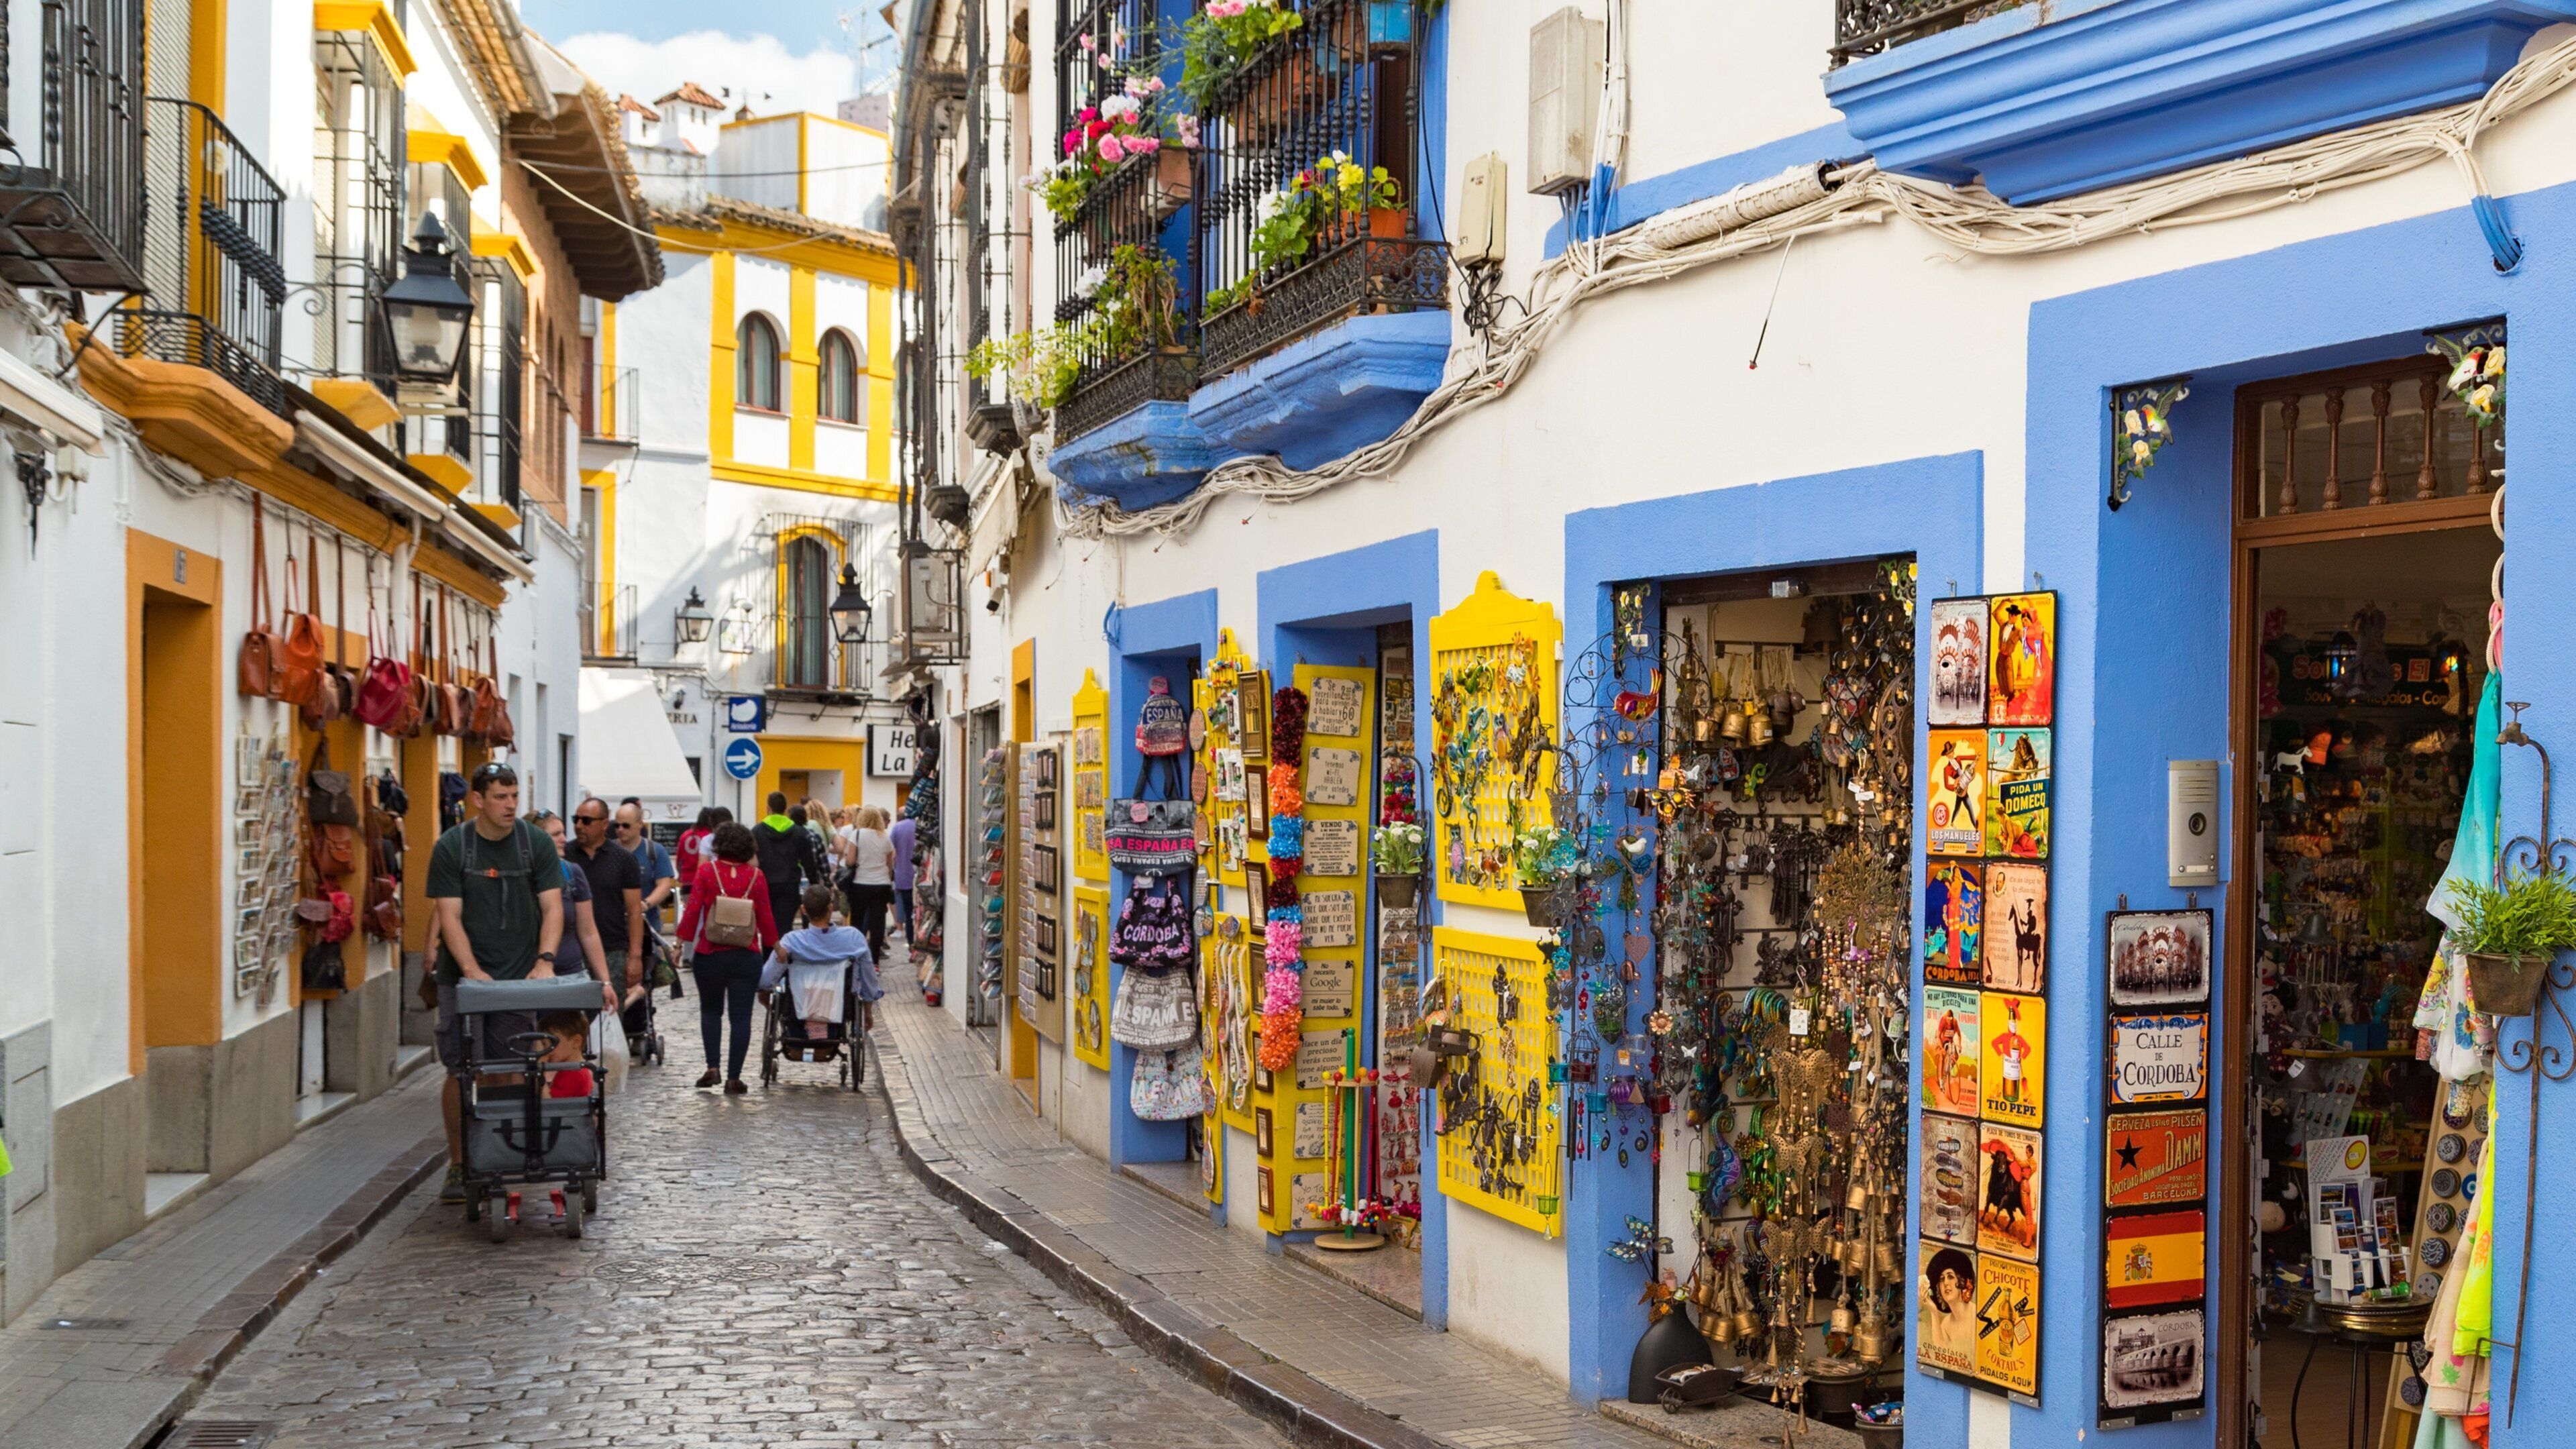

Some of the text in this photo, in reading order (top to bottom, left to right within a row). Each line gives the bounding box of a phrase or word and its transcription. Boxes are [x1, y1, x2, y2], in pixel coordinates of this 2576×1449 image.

[1146, 706, 1183, 724] ESPAÑA
[1319, 706, 1338, 715] hablar
[1342, 706, 1354, 720] 60
[882, 754, 906, 771] La
[2010, 782, 2043, 796] PIDA UN
[2005, 792, 2046, 814] DOMECQ
[1127, 837, 1177, 851] ESPAÑA
[1931, 830, 1980, 842] LOS MANUELES
[1322, 894, 1342, 902] SUEGRA
[1318, 904, 1328, 912] QUE
[1330, 904, 1340, 912] SOY
[1305, 914, 1352, 924] SABE QUE EXISTO
[1124, 922, 1180, 943] CÓRDOBA
[1324, 934, 1334, 943] VER
[1309, 976, 1341, 991] Google
[1123, 1002, 1179, 1027] ESPAÑA
[2136, 1032, 2183, 1049] CALLE
[1307, 1047, 1337, 1057] precioso
[2155, 1052, 2163, 1061] DE
[2123, 1061, 2198, 1087] CÓRDOBA
[1986, 1099, 2007, 1111] TIO
[2009, 1103, 2037, 1116] PEPE
[2111, 1118, 2151, 1132] CERVEZA
[2171, 1115, 2203, 1128] PILSEN
[2110, 1175, 2139, 1197] SOCIEDAD
[2165, 1130, 2202, 1173] DAMM
[2143, 1188, 2198, 1200] BARCELONA
[1984, 1269, 2031, 1296] CHICOTE
[2158, 1322, 2196, 1333] CÓRDOBA
[1917, 1347, 1973, 1371] LA ESPAÑA
[1923, 1342, 1968, 1360] chocolates
[1986, 1348, 2025, 1372] COKTAIL'S
